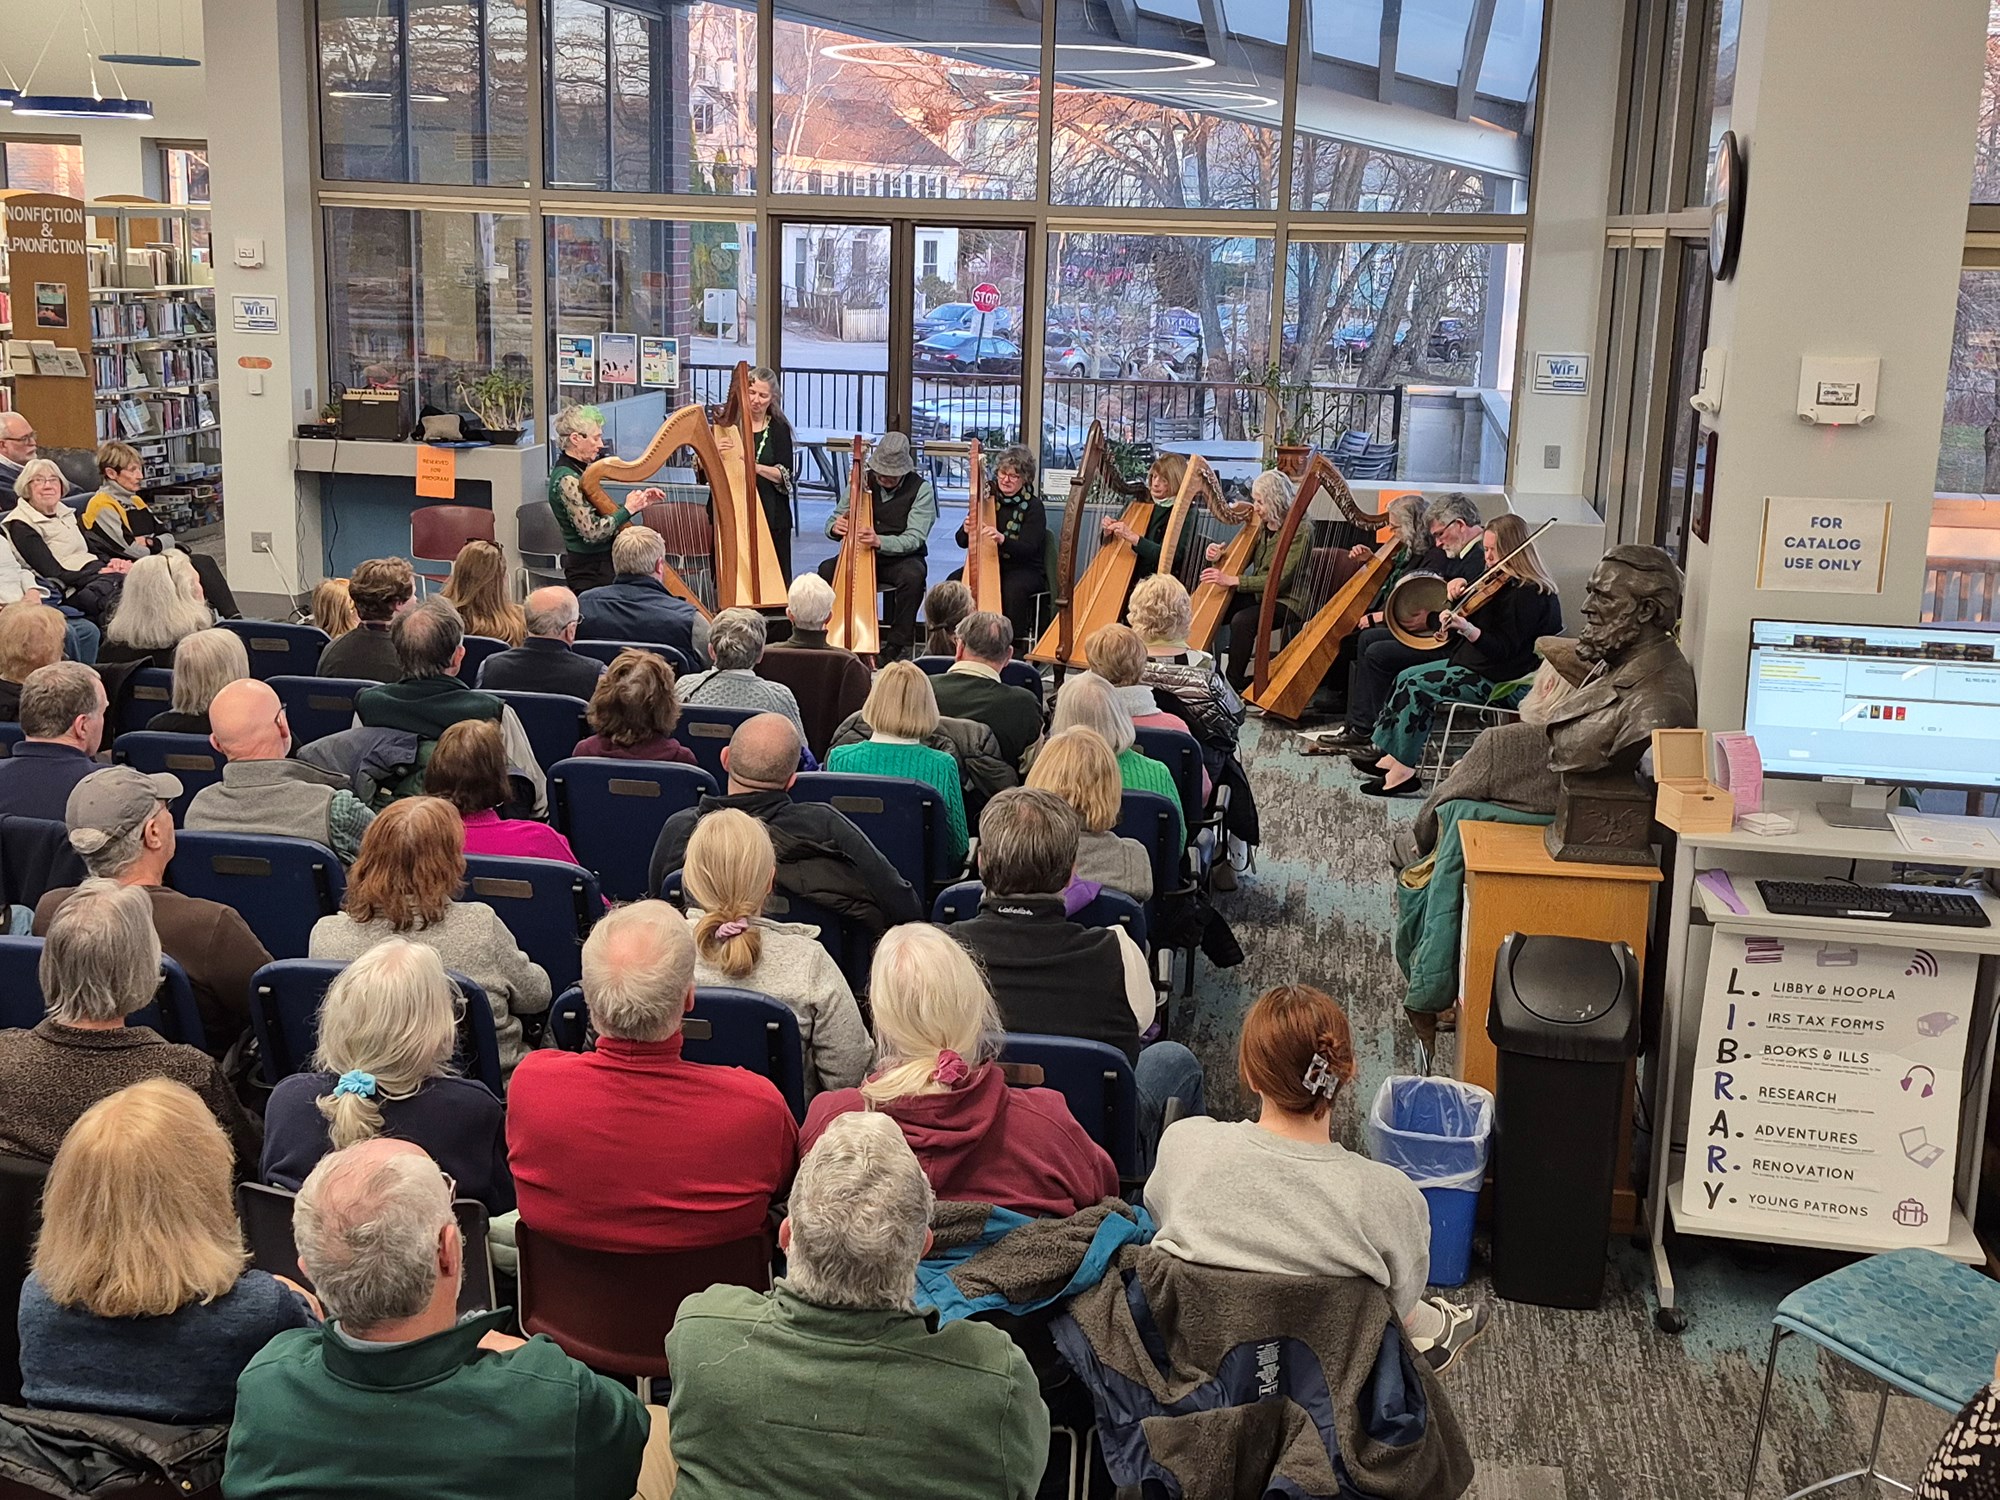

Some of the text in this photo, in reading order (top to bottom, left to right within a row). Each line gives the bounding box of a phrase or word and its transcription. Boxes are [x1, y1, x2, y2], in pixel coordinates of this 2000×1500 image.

[6, 206, 83, 223] NONFICTION
[41, 222, 54, 237] &
[7, 237, 85, 254] LPNONFICTION
[974, 291, 999, 305] STOP
[1811, 516, 1842, 529] FOR
[1784, 536, 1861, 550] CATALOG
[1784, 557, 1862, 571] USE ONLY
[1773, 982, 1814, 994] LIBBY
[1817, 984, 1827, 995] &
[1832, 985, 1896, 1000] HOOPLA
[1767, 1012, 1791, 1024] IRS
[1796, 1014, 1825, 1026] TAX
[1831, 1017, 1885, 1031] FORMS
[1764, 1045, 1818, 1059] BOOKS
[1823, 1049, 1832, 1060] &
[1838, 1050, 1870, 1064] ILLS
[1758, 1086, 1837, 1104] RESEARCH
[1755, 1124, 1858, 1145] ADVENTURES
[1752, 1158, 1854, 1181] RENOVATION
[1749, 1193, 1799, 1209] YOUNG
[1804, 1200, 1869, 1217] PATRONS
